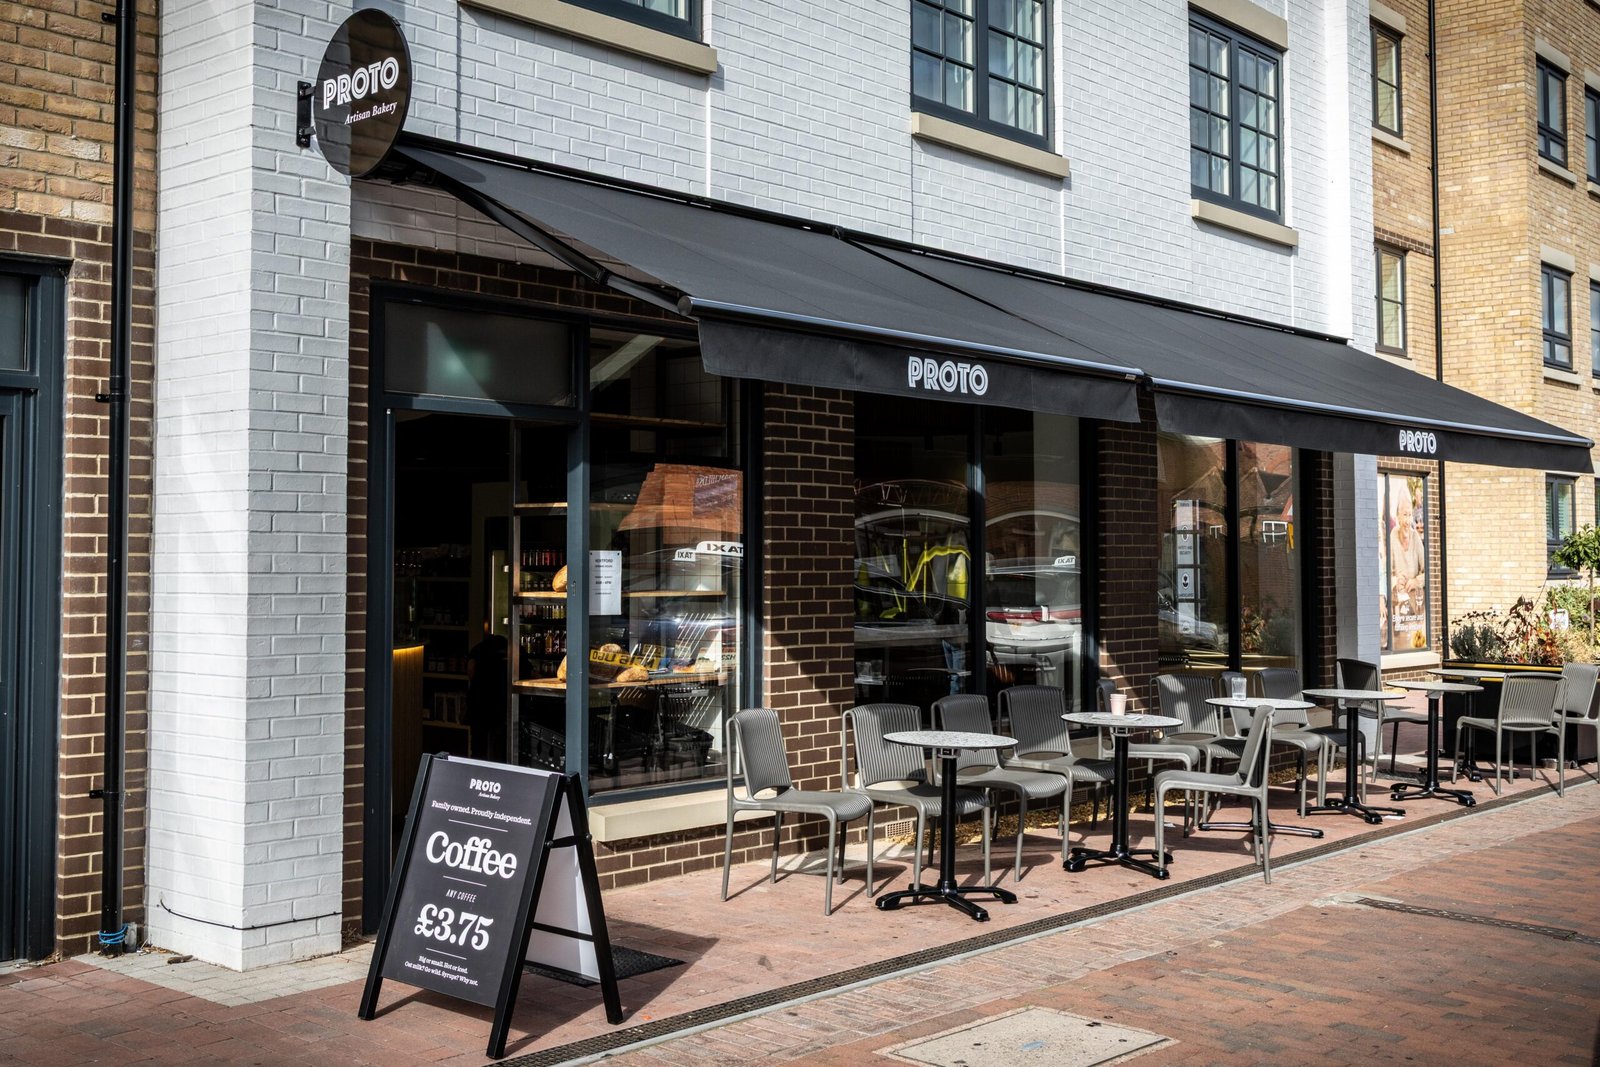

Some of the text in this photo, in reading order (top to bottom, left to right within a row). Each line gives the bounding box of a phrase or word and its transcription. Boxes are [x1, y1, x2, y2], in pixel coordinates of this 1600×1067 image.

[323, 57, 399, 110] PROTO
[344, 102, 397, 125] Artisan Bakery
[908, 356, 989, 396] PROTO
[1399, 430, 1437, 454] PROTO
[469, 779, 501, 793] PROTO
[431, 800, 532, 825] Family owned. Proudly independent.
[426, 831, 517, 879] Coffee
[445, 889, 477, 903] ANY COFFEE
[414, 903, 494, 951] £3.75
[418, 955, 427, 964] Big
[443, 962, 452, 970] Hot
[459, 975, 470, 985] Why
